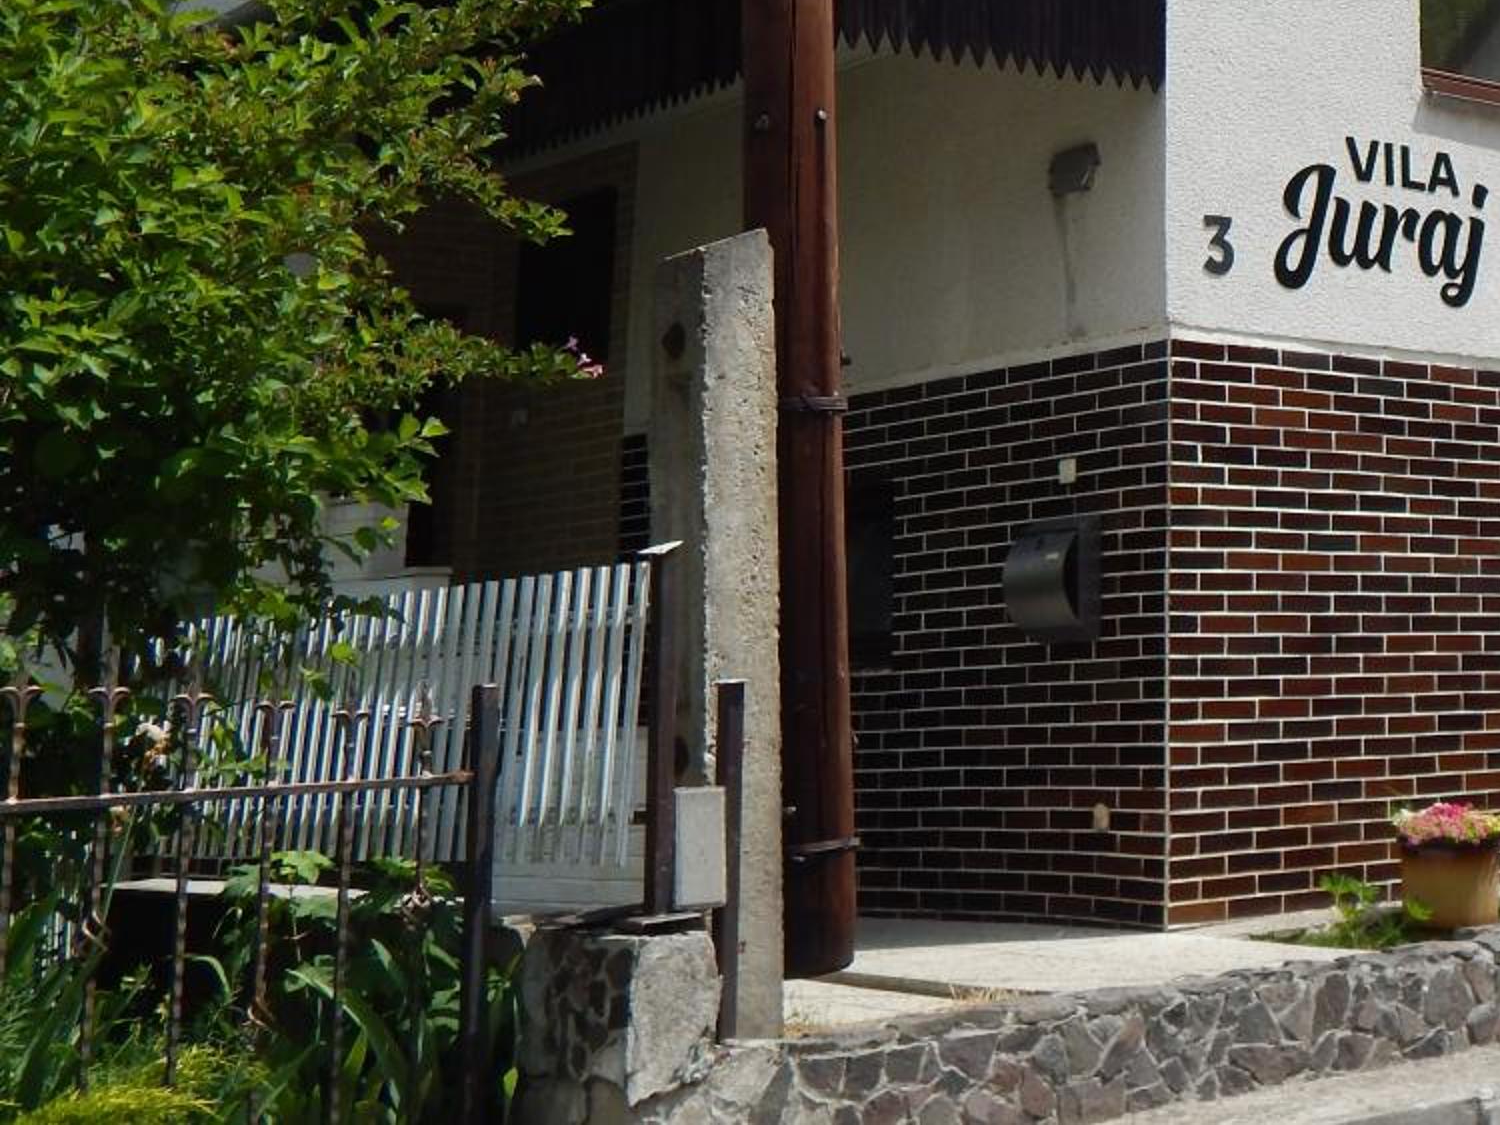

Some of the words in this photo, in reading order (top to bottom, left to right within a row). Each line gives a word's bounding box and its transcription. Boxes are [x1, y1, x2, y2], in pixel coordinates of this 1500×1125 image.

[1345, 136, 1460, 198] VILA
[1202, 214, 1235, 276] 3
[1273, 163, 1489, 308] Juraj
